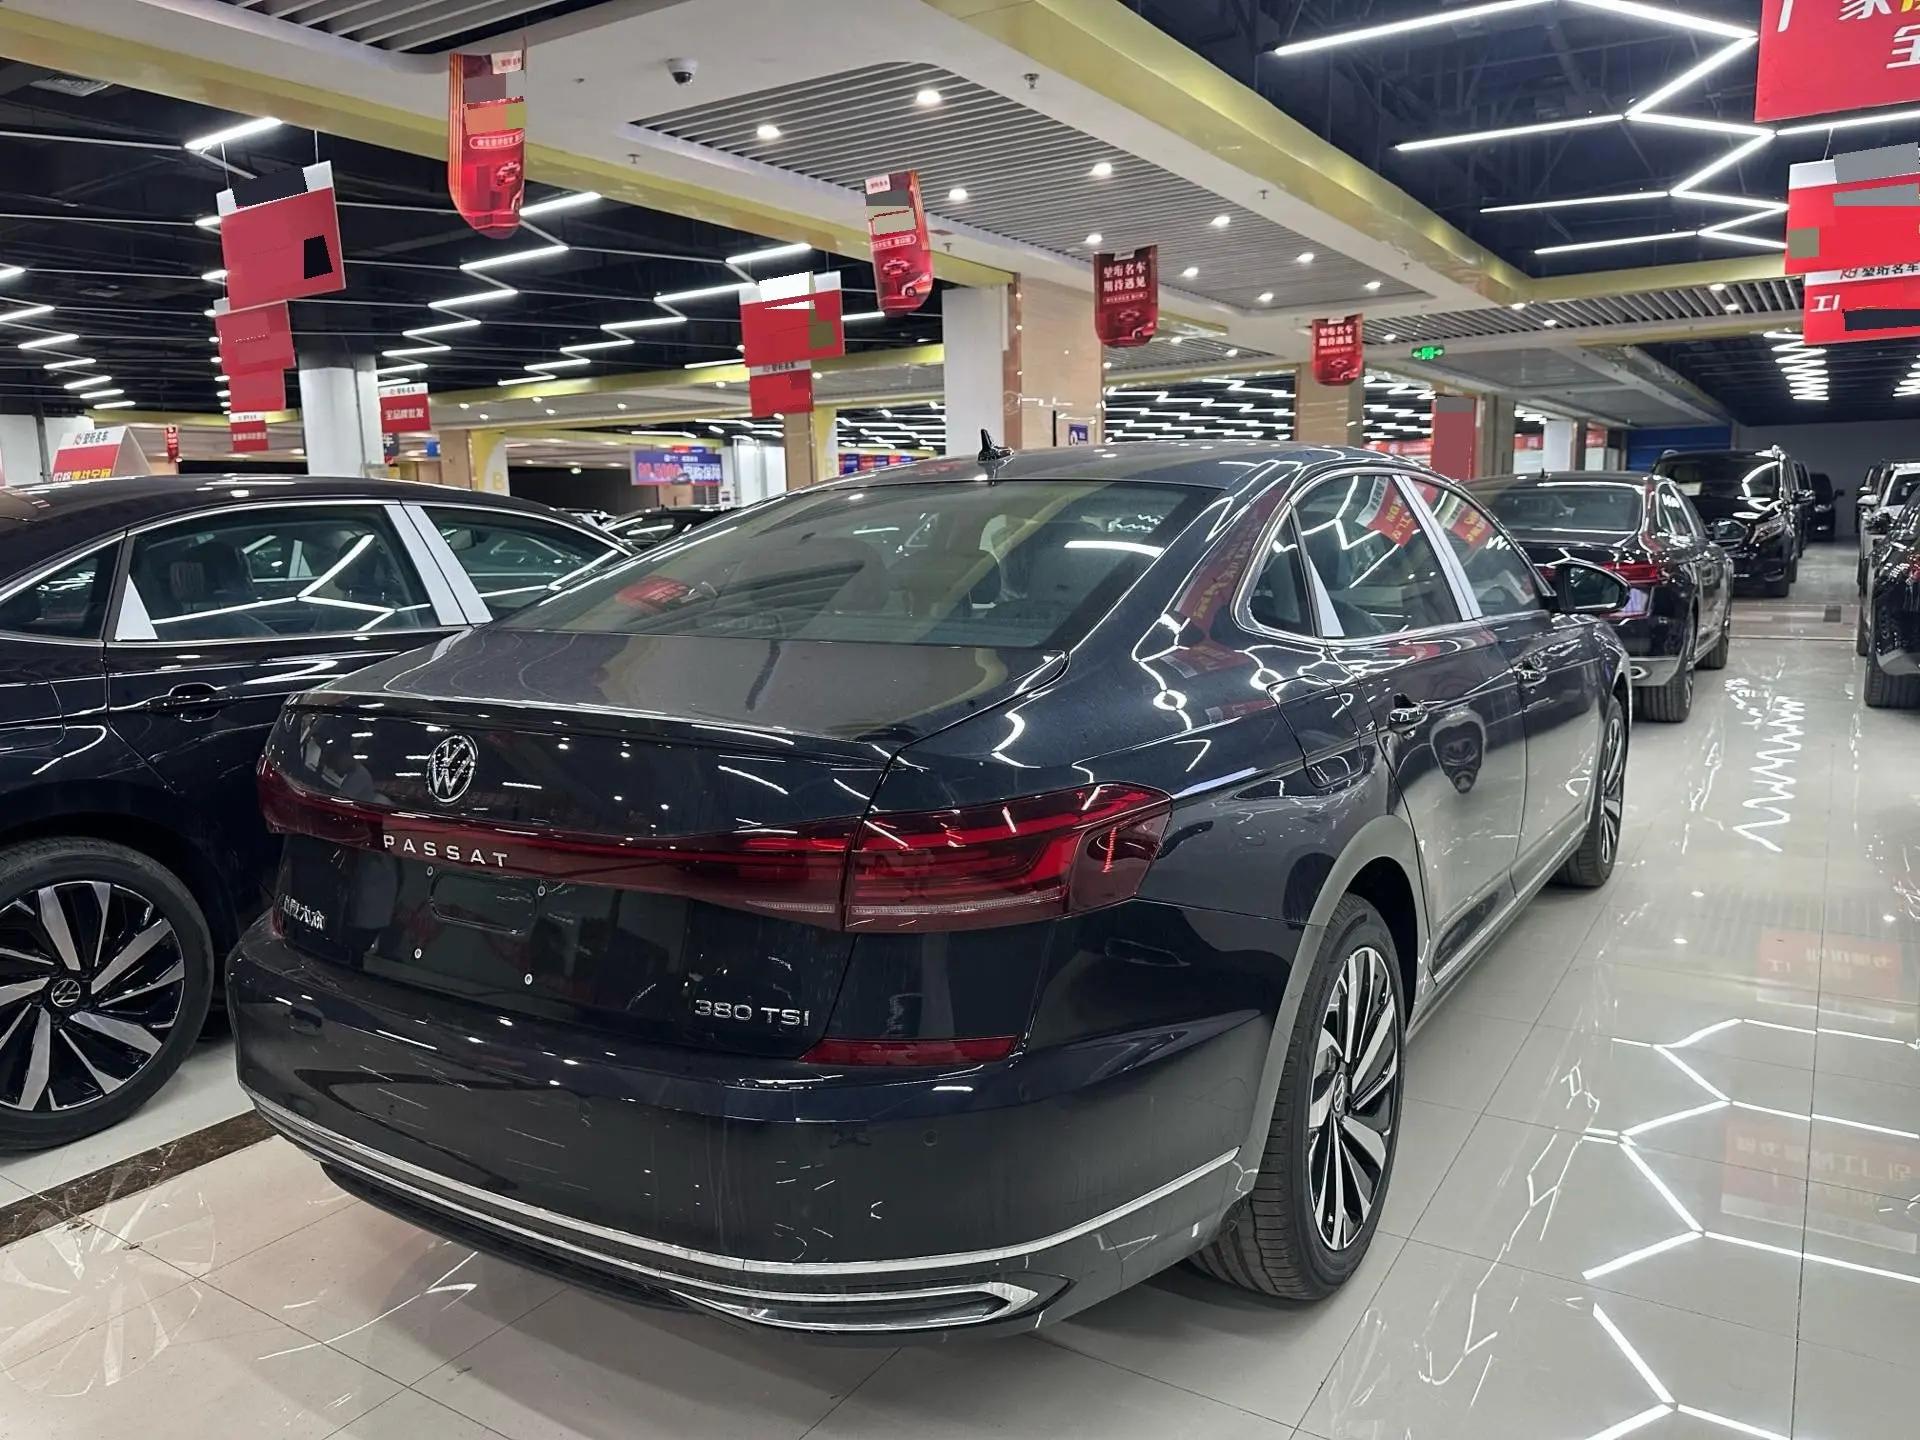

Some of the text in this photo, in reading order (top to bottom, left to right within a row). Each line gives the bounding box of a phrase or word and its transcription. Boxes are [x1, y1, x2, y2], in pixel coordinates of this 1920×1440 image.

[383, 834, 508, 868] PASSAT
[694, 999, 810, 1027] 380 TSI
